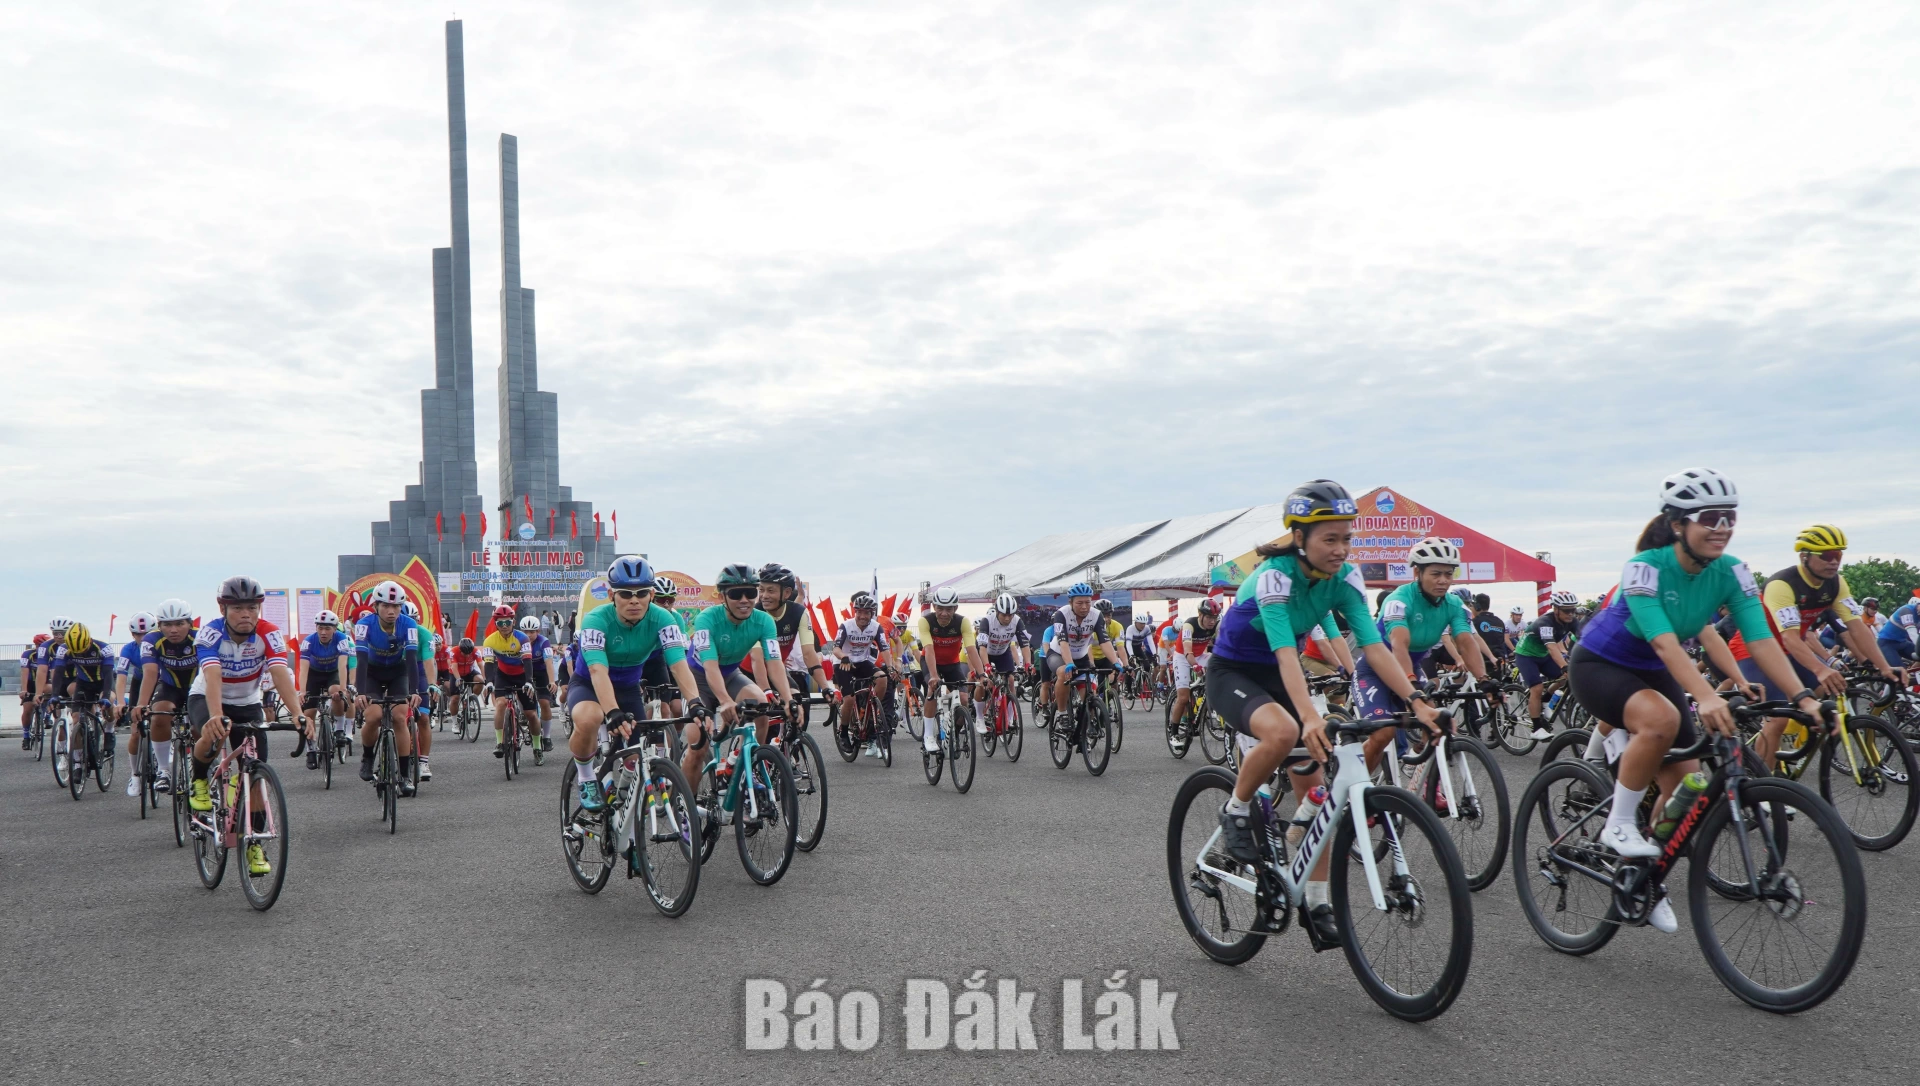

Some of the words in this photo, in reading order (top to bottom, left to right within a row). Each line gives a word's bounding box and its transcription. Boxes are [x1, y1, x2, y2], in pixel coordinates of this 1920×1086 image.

[1290, 503, 1305, 515] 1C
[1337, 502, 1353, 514] 1C
[1364, 516, 1389, 531] ĐUA
[1391, 516, 1408, 531] XE
[1410, 516, 1434, 535] ĐẠP
[1365, 535, 1377, 547] MỞ
[1378, 536, 1396, 549] RỘNG
[472, 547, 491, 566] LỄ
[499, 551, 540, 566] KHAI
[547, 551, 585, 569] MẠC
[481, 571, 498, 580] ĐUA
[563, 571, 578, 580] TUY
[1264, 570, 1283, 594] 18
[1630, 564, 1651, 586] 20
[684, 587, 702, 599] ĐẠP
[582, 629, 603, 646] 346
[661, 625, 681, 644] 346
[1292, 793, 1337, 886] GIANT
[1656, 794, 1709, 873] S-WORKS
